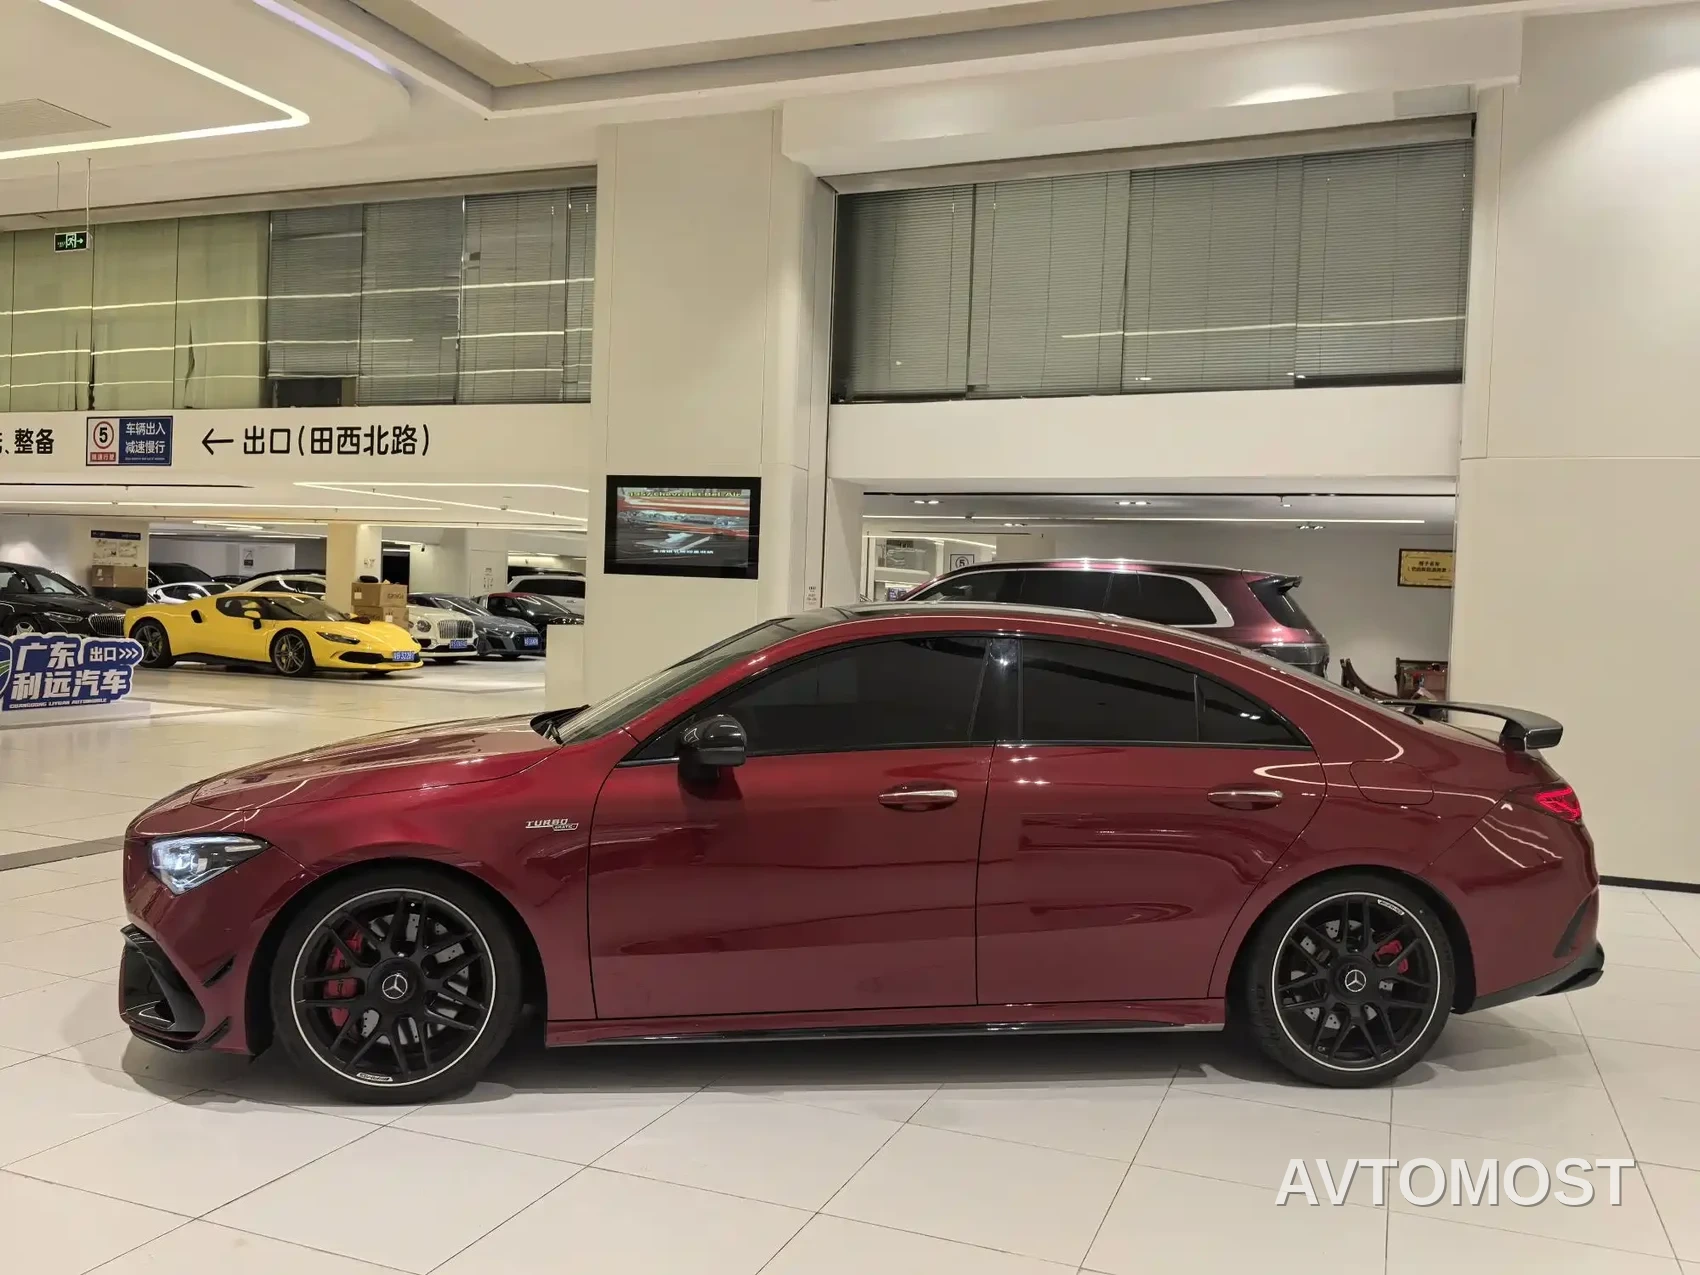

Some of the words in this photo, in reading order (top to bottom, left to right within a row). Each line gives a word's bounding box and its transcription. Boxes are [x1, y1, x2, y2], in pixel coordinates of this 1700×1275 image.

[99, 426, 108, 443] 5
[125, 422, 166, 436] 车辆出入
[0, 427, 54, 455] 、整备
[125, 440, 166, 454] 减速慢行
[15, 641, 77, 671] 广东
[89, 646, 117, 662] 出口
[11, 669, 128, 700] 利远汽车
[525, 819, 568, 827] TURBO
